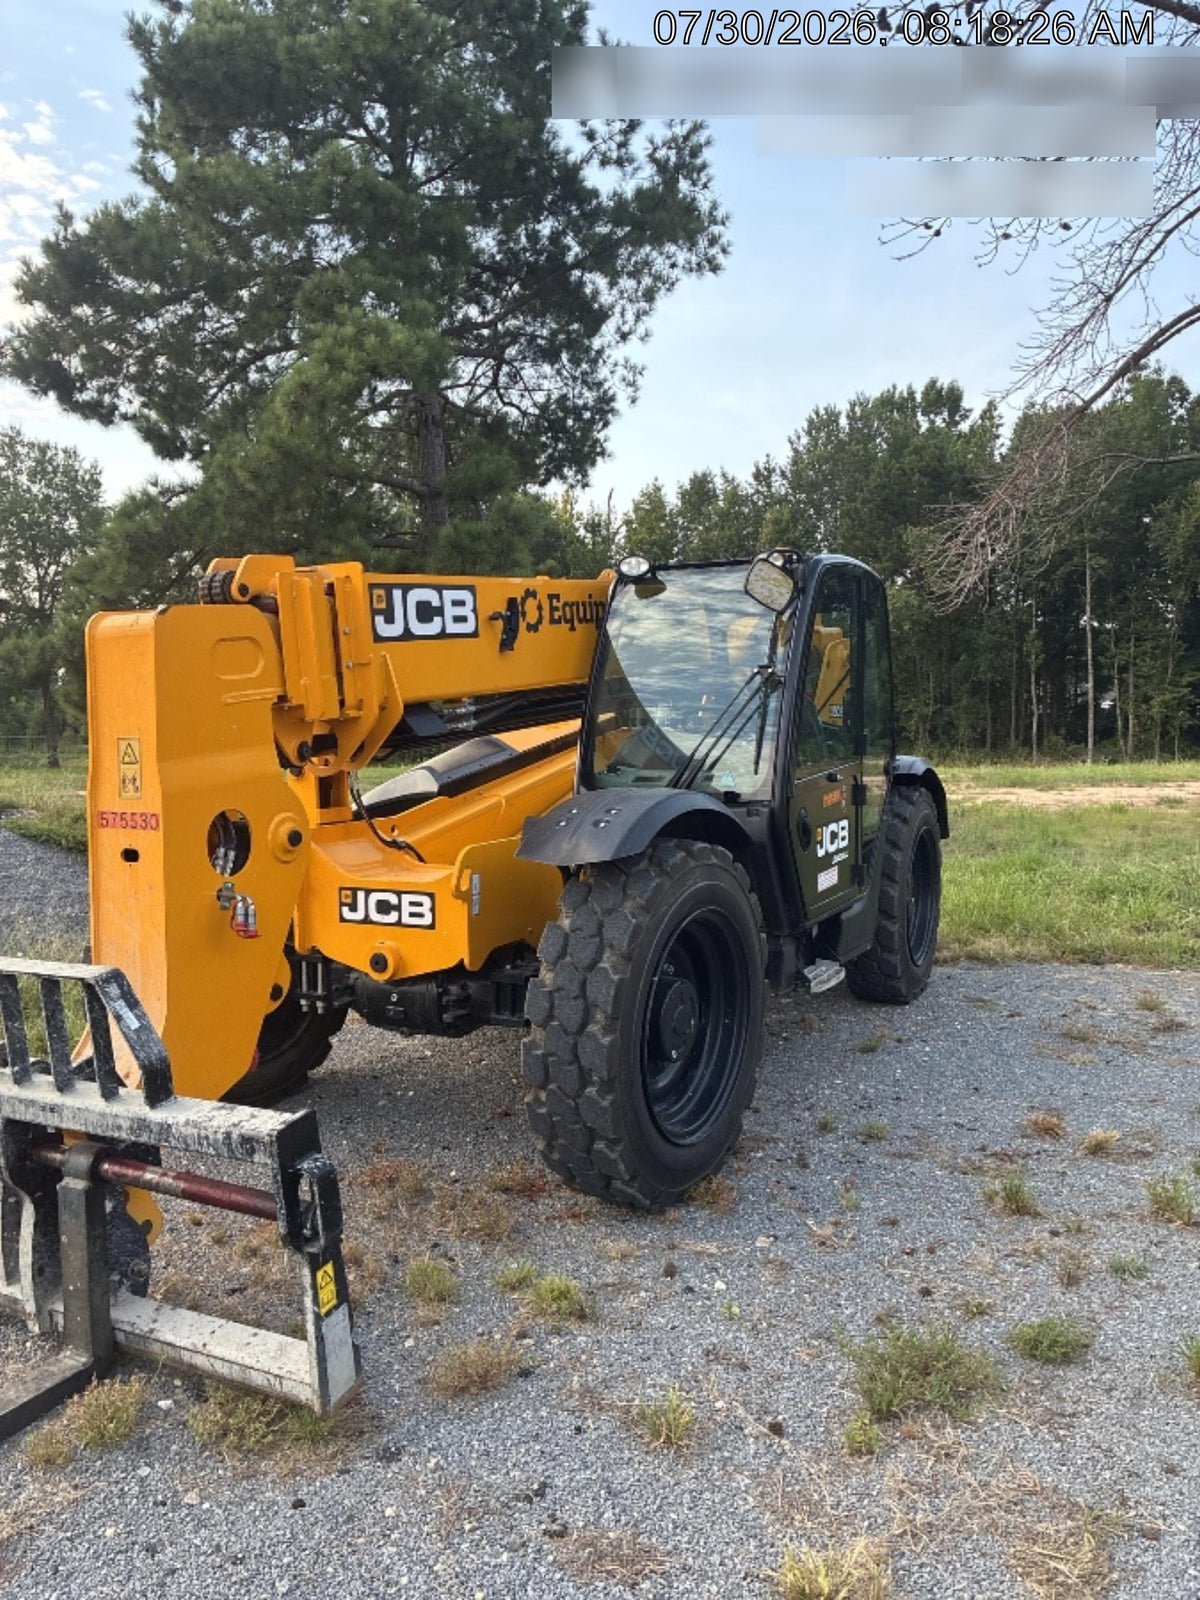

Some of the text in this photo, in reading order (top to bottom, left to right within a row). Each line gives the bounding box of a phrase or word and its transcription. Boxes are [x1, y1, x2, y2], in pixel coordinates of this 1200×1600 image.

[374, 588, 478, 638] JCB
[100, 811, 159, 831] 575530
[816, 818, 849, 858] JCB
[341, 890, 433, 925] JCB
